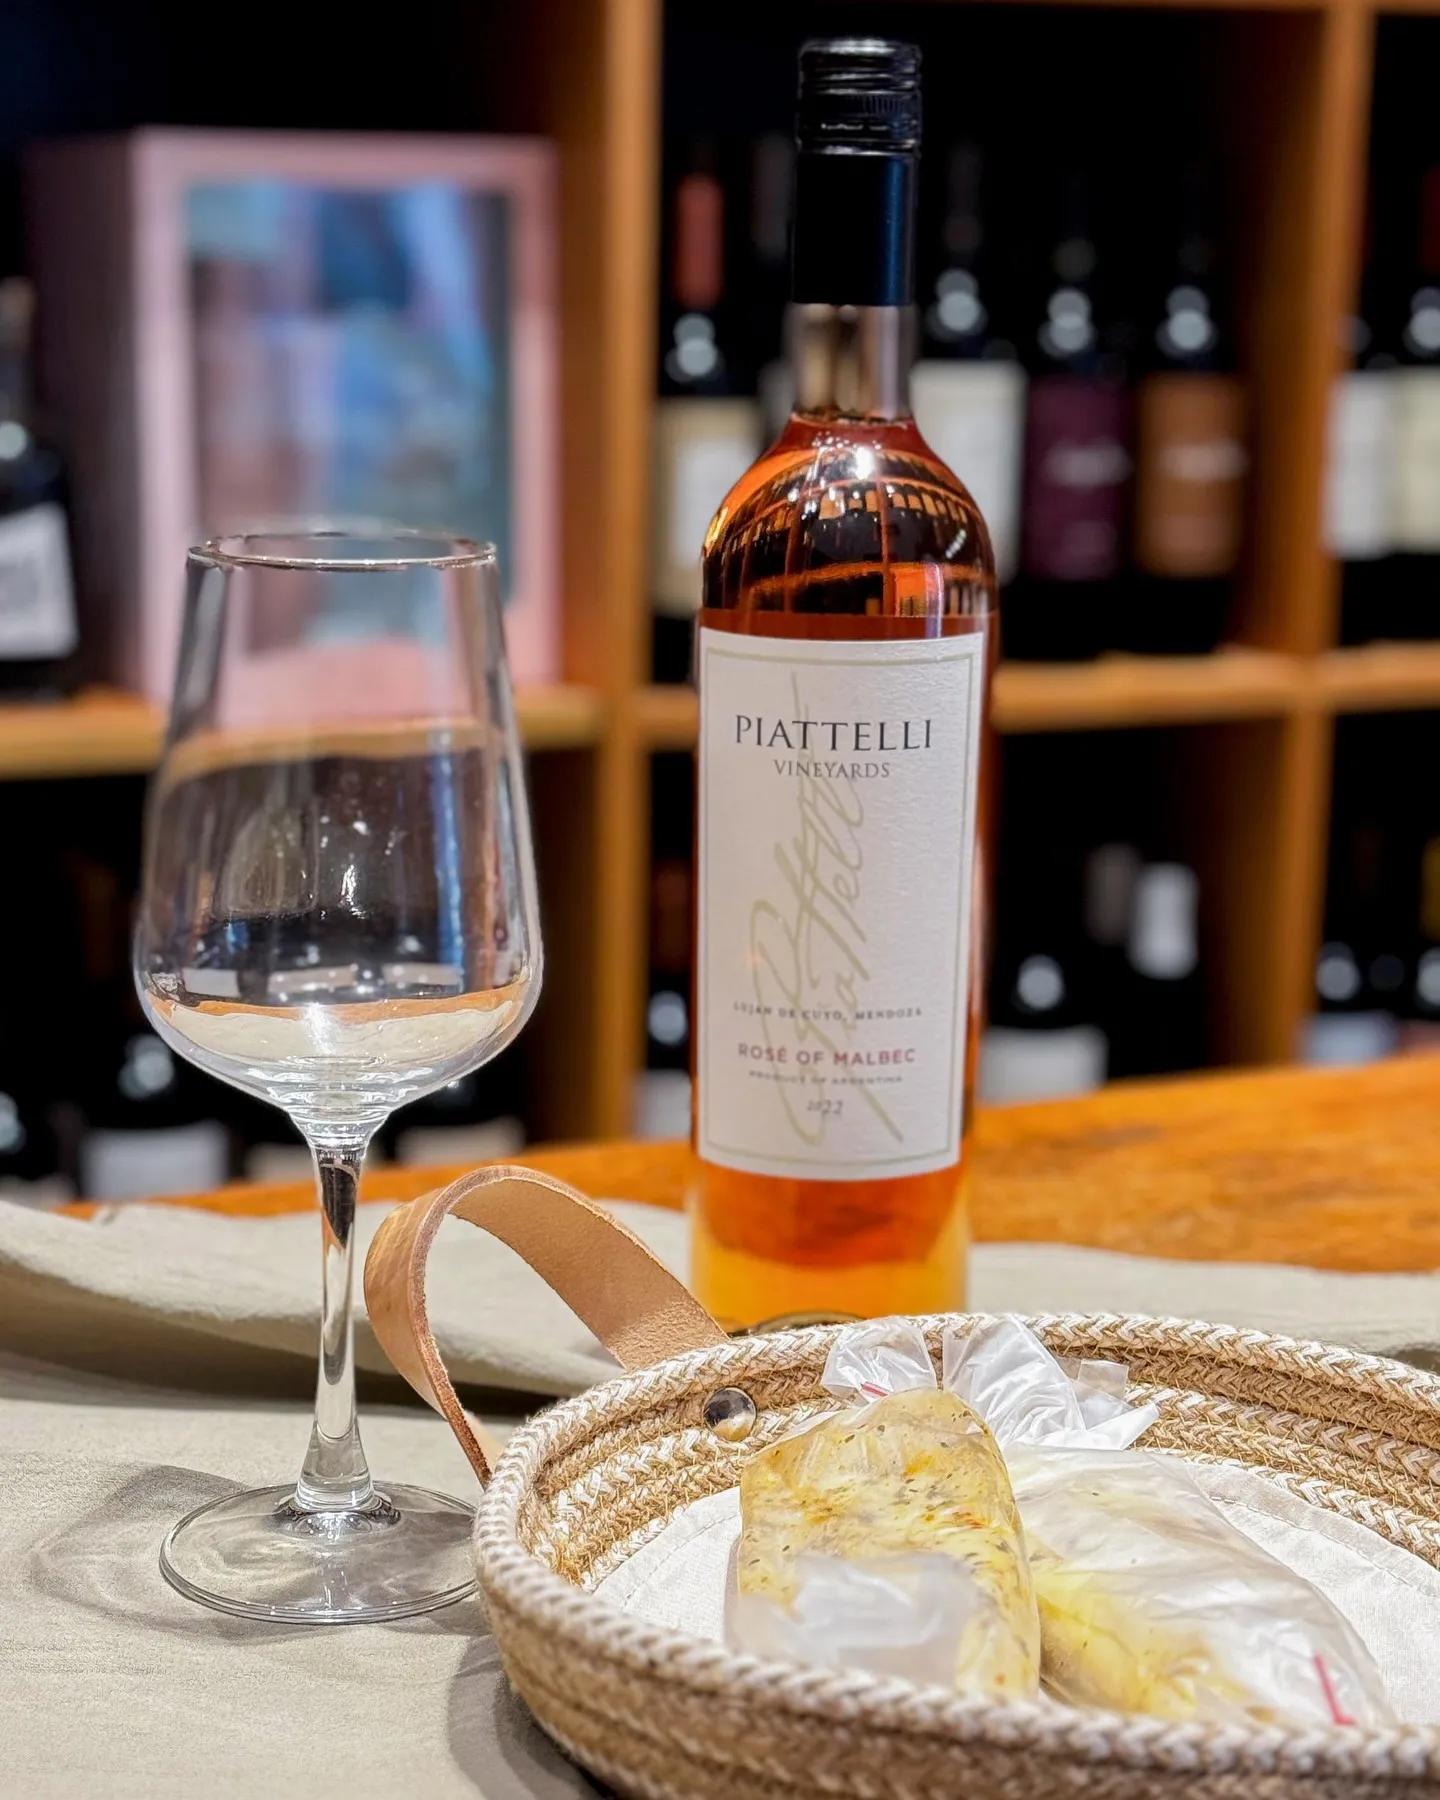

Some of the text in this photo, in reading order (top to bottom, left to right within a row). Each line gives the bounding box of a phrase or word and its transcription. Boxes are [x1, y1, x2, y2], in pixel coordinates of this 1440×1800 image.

[735, 714, 932, 752] PIATTELLI
[773, 758, 891, 779] VINEYARDS
[778, 1007, 796, 1019] DE
[854, 1007, 923, 1021] MENDOZA
[737, 1042, 916, 1067] ROSÉ OF MALBEC
